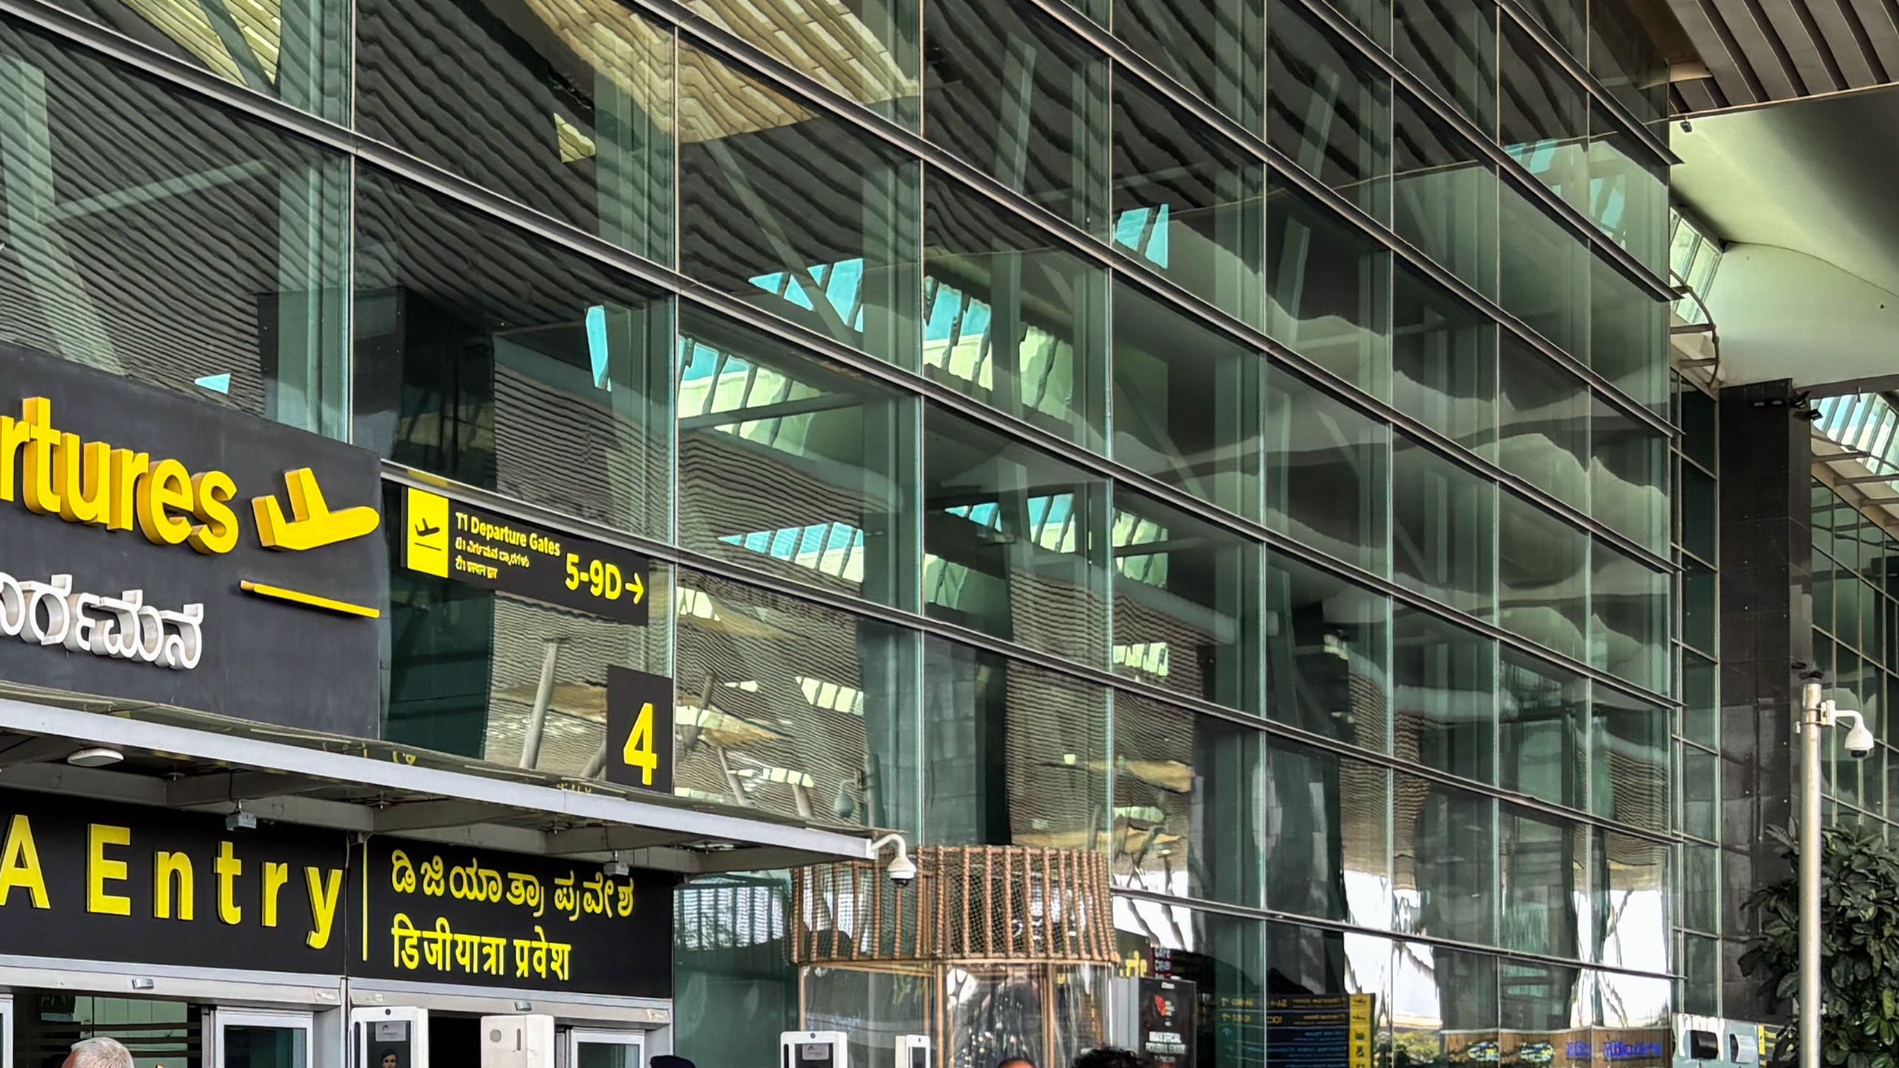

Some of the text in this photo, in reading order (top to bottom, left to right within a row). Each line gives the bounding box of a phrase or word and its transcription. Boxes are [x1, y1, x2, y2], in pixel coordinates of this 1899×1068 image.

[455, 512, 561, 557] T1 Departure Gates
[565, 553, 622, 600] 5-9D
[623, 703, 658, 785] 4
[86, 824, 343, 949] Entry
[391, 849, 634, 922] ಡಿಜಿಯಾತ್ರಾ ಪ್ರವೇಶ
[391, 912, 572, 981] डिजीयात्रा प्रवेश
